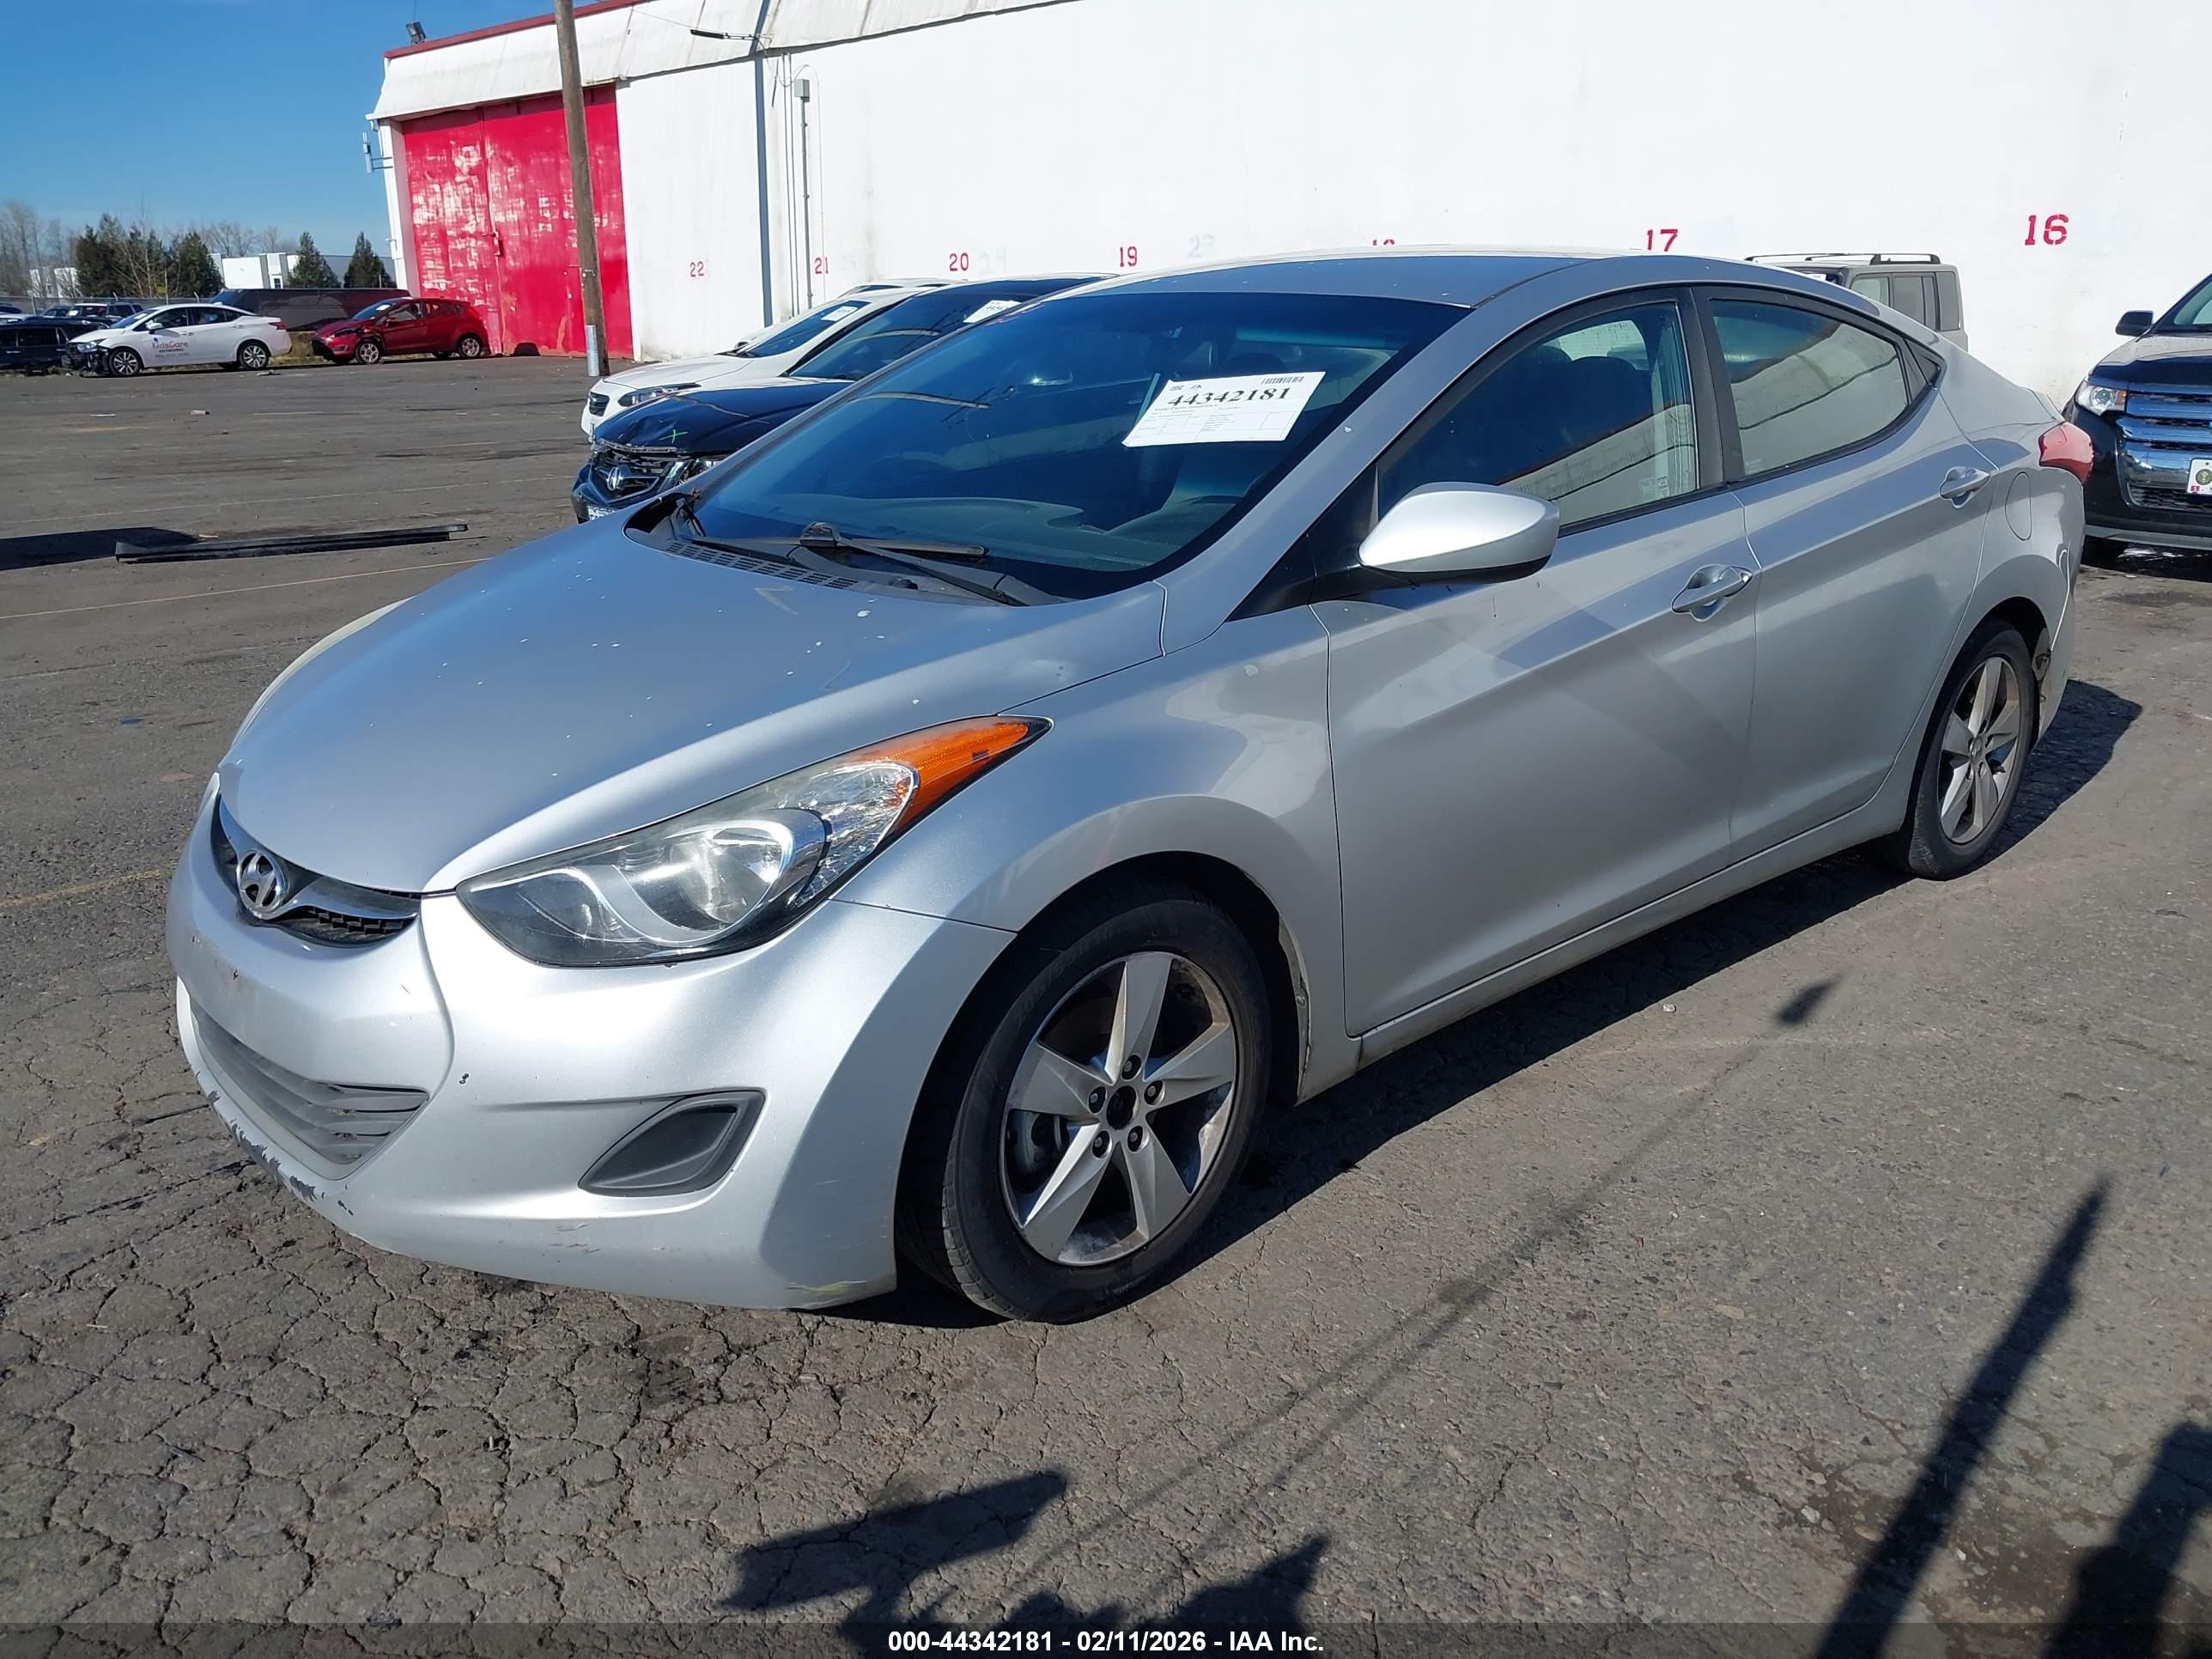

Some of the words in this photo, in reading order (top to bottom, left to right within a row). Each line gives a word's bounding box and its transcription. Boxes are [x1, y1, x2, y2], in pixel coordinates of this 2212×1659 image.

[1647, 228, 1679, 252] 17
[2024, 214, 2069, 246] 16
[815, 257, 830, 275] 21
[949, 252, 969, 272] 20
[1120, 246, 1138, 267] 19
[690, 261, 704, 277] 22
[1168, 386, 1291, 406] 44342181
